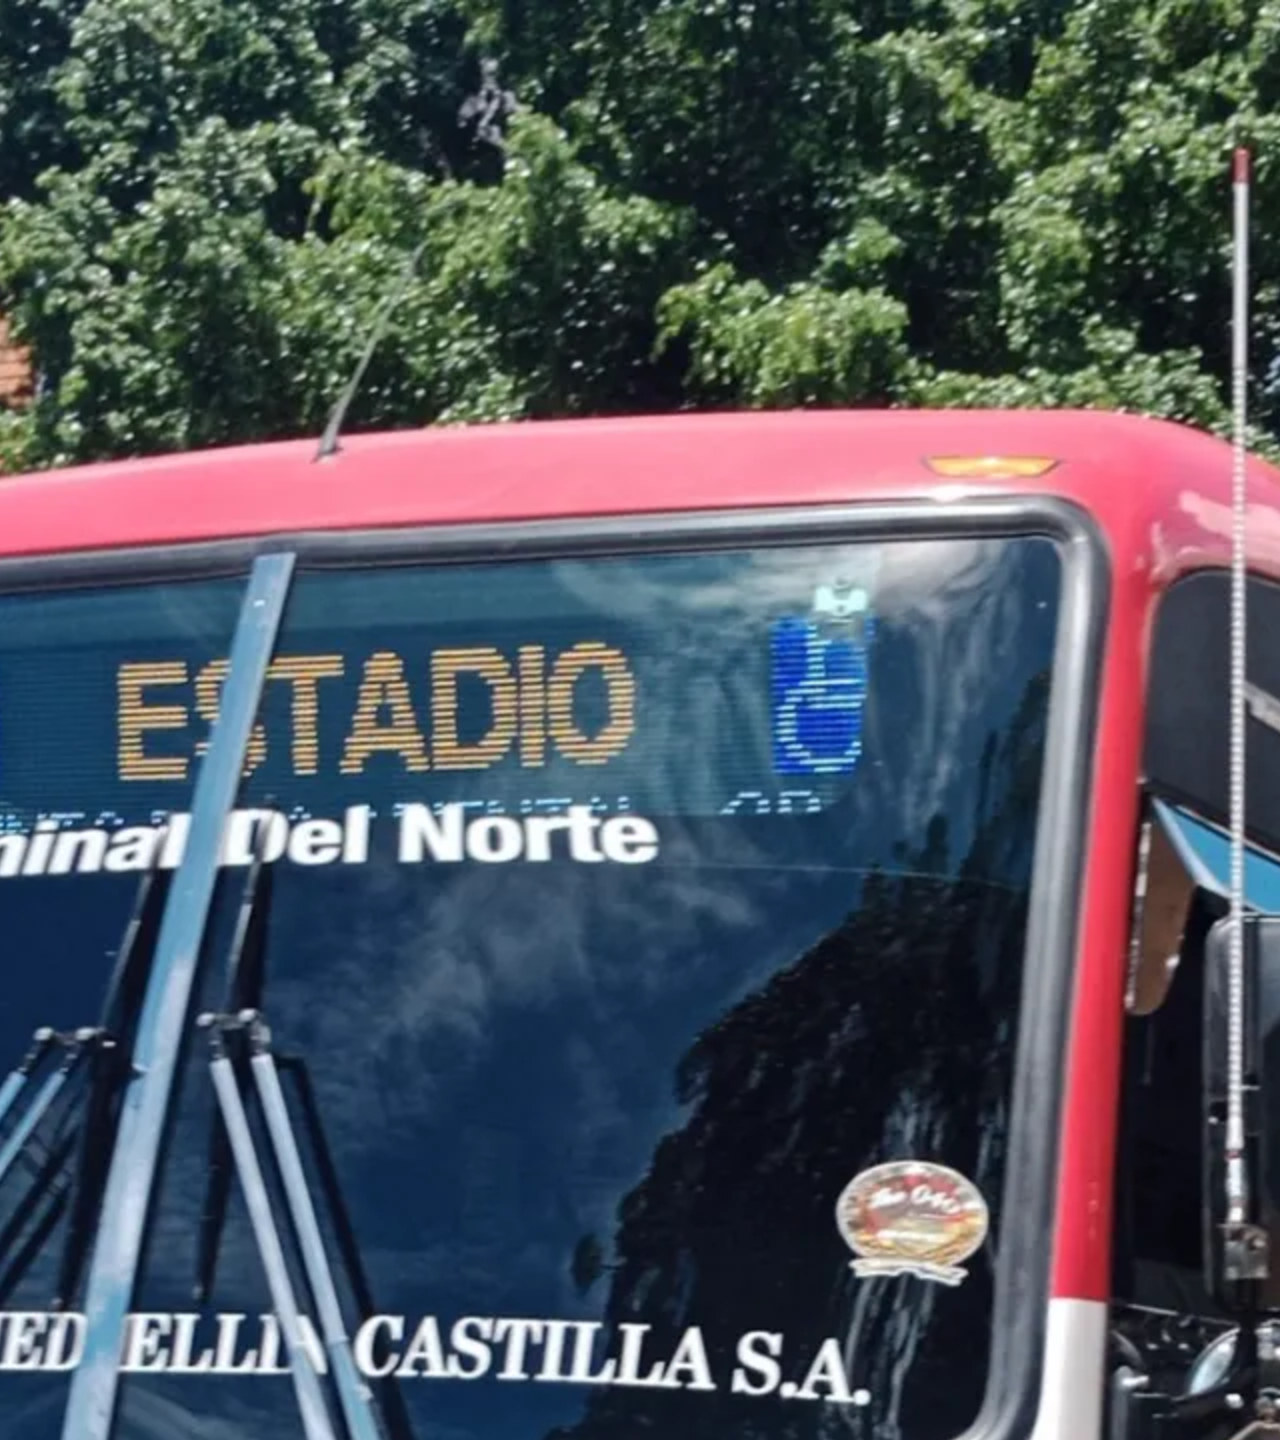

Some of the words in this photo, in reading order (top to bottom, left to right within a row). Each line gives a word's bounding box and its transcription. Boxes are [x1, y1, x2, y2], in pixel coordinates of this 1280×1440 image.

[217, 806, 369, 866] Del
[398, 805, 659, 863] Norte
[354, 1314, 716, 1390] CASTILLA
[732, 1330, 871, 1405] S.A.
